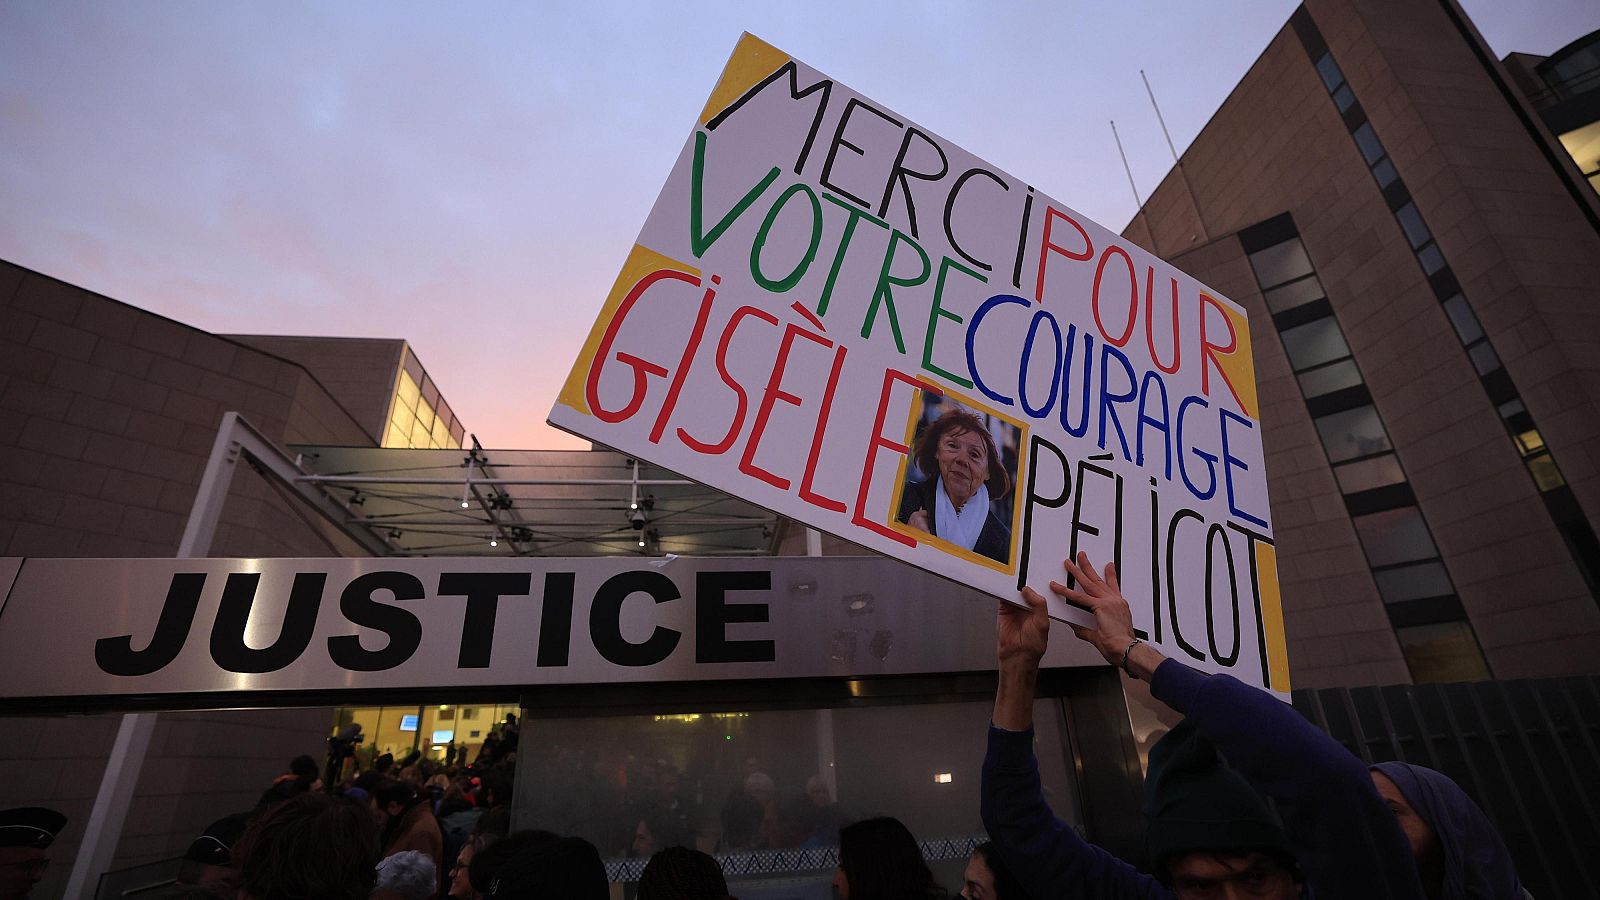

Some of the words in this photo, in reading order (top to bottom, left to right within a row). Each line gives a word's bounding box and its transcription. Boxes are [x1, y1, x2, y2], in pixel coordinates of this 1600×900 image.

[691, 131, 988, 389] VOTRE
[965, 294, 1268, 528] COURAGE
[1035, 206, 1248, 416] POUR
[94, 570, 777, 677] JUSTICE
